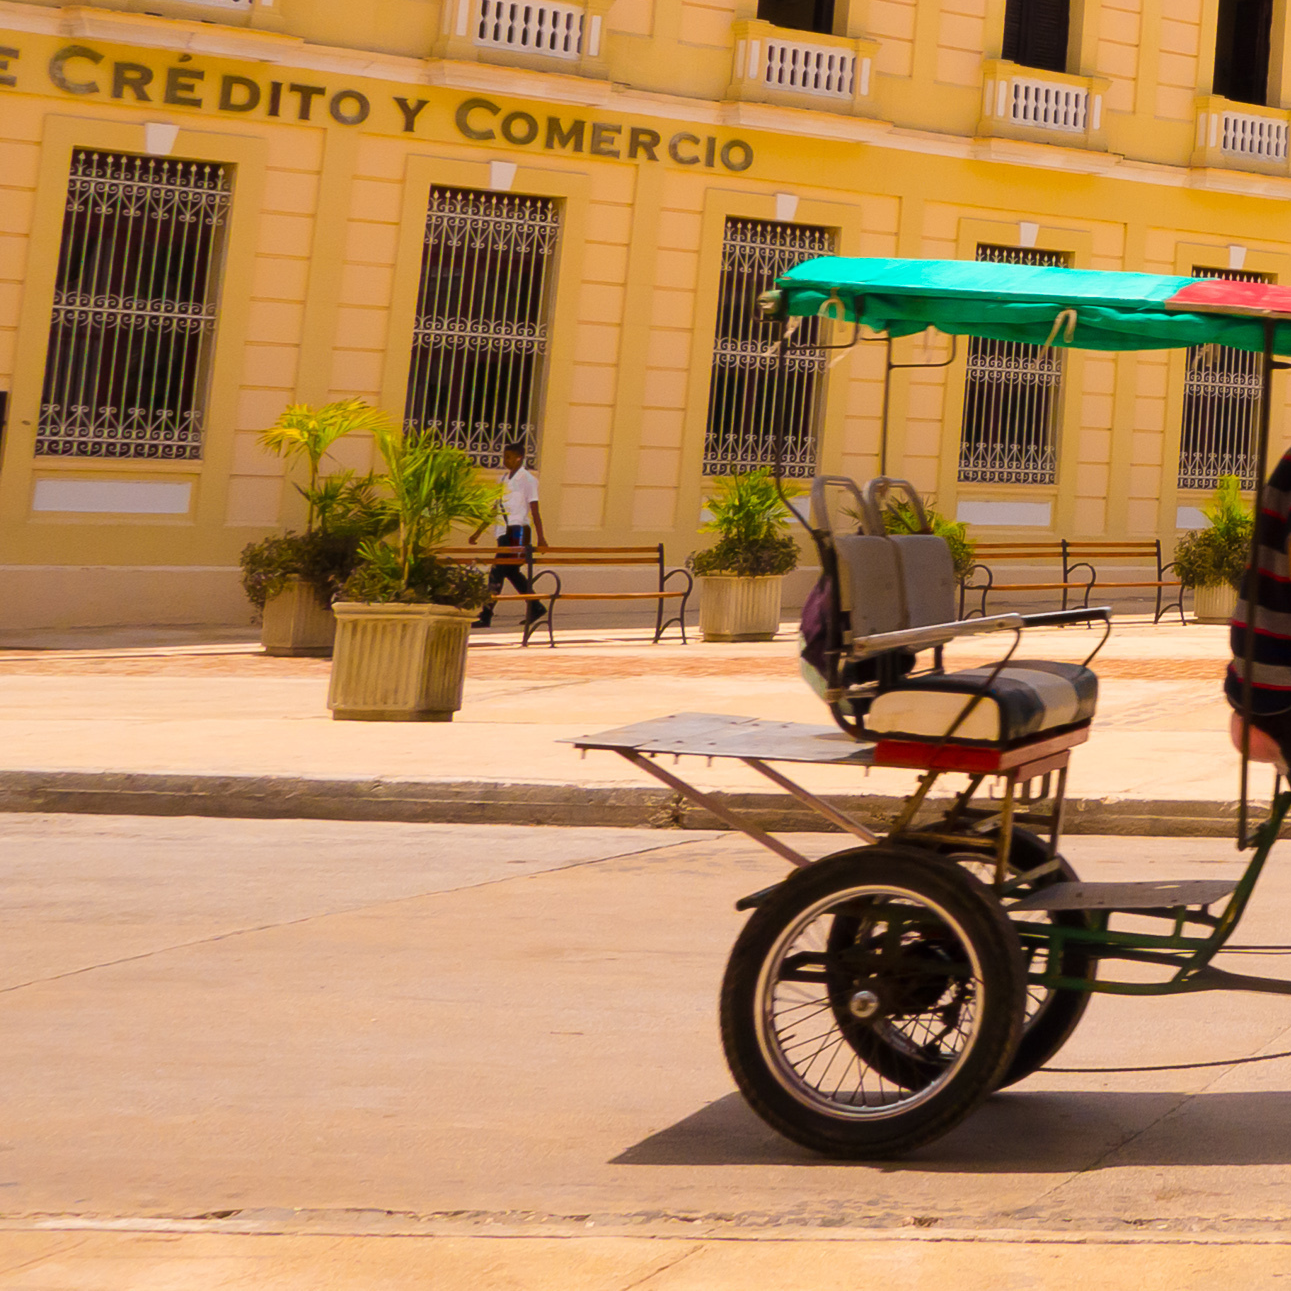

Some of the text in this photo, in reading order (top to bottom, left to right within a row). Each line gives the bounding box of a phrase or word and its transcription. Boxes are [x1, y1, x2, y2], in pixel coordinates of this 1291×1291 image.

[48, 44, 371, 126] CRÉDITO
[391, 96, 431, 133] Y
[455, 97, 755, 172] COMERCIO
